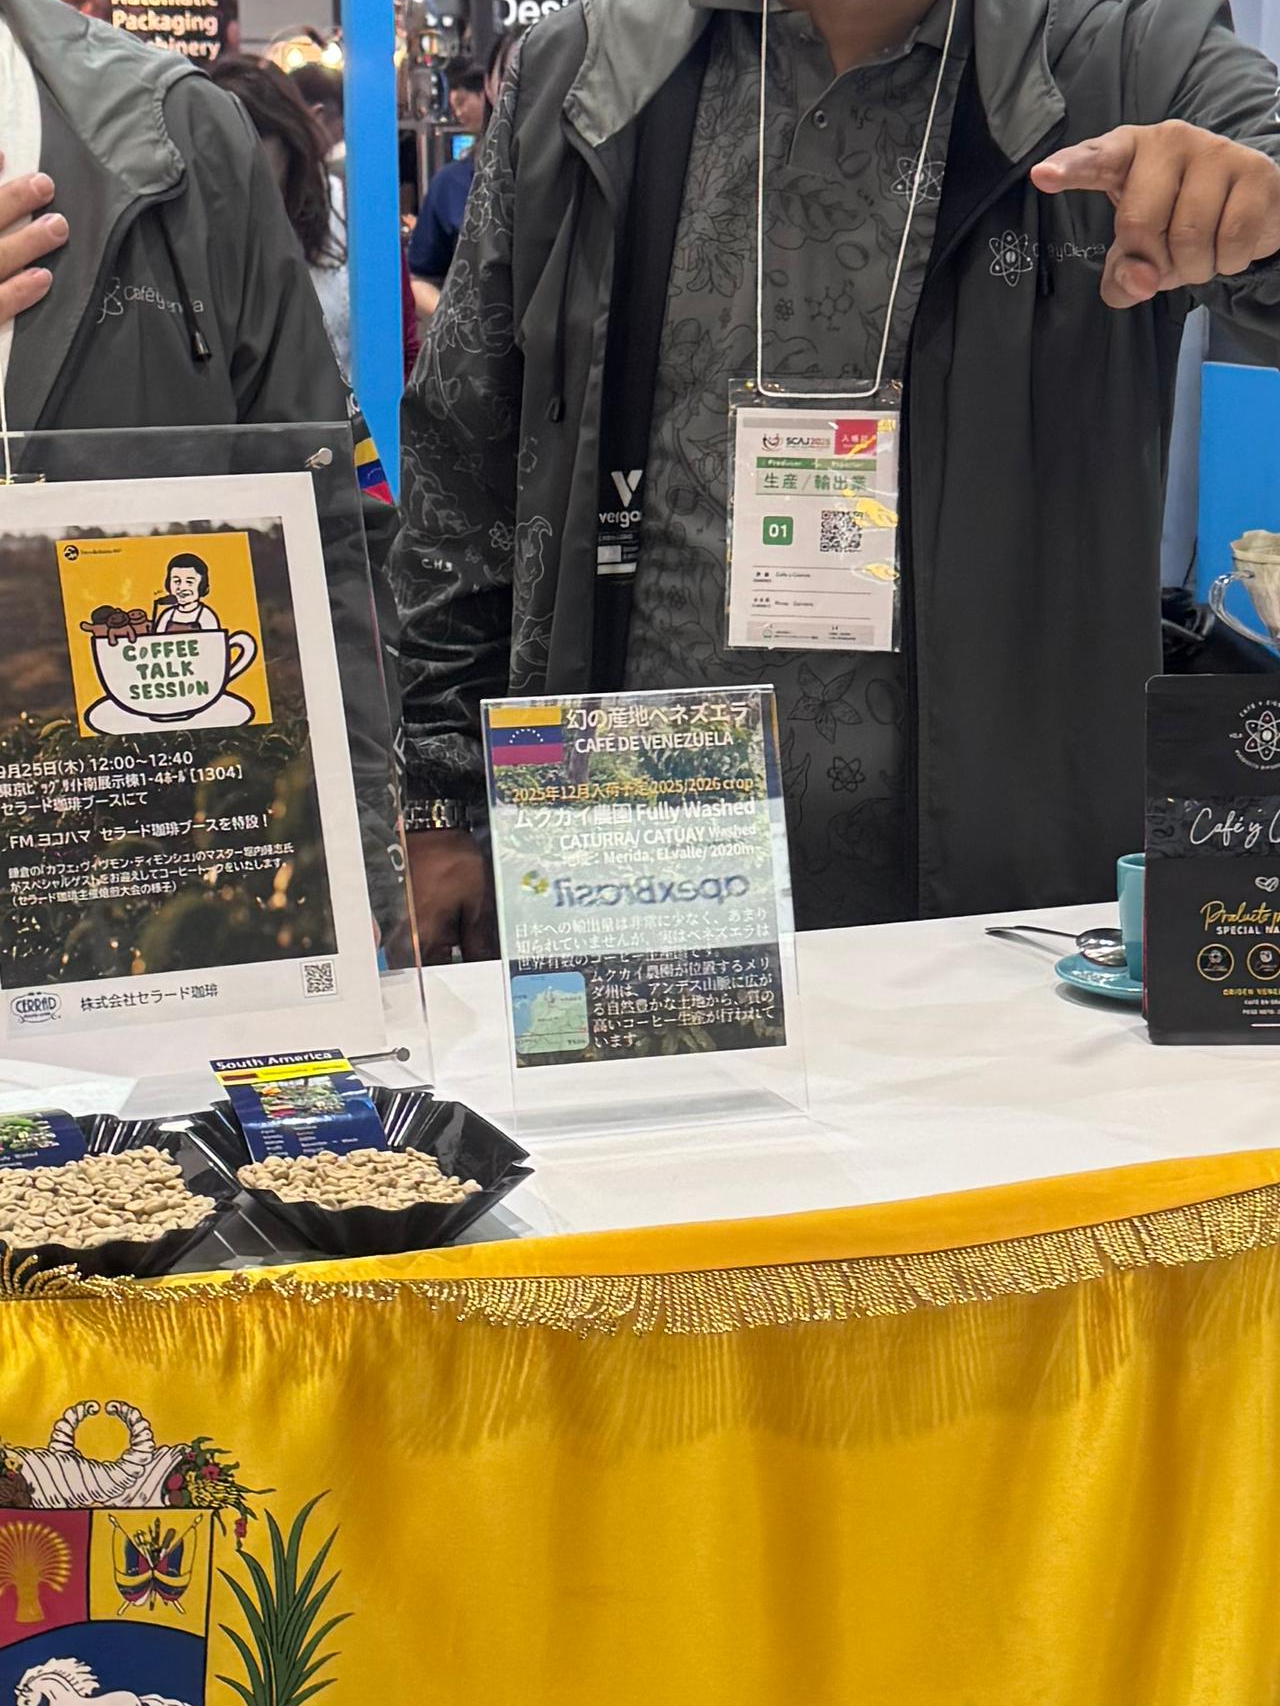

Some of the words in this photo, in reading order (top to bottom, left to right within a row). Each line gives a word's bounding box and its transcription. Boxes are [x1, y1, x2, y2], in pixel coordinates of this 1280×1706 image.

[112, 9, 218, 36] Packaging
[769, 524, 788, 538] 01
[122, 639, 199, 662] COFFEE
[136, 661, 195, 679] TALK
[129, 681, 209, 700] SESSION
[567, 702, 749, 730] 幻の産地ベネズエラ
[575, 733, 613, 753] CAFÉ
[621, 737, 640, 751] DE
[643, 732, 733, 750] VENEZUELA
[652, 778, 721, 796] 2025/2026
[723, 777, 753, 793] crop
[0, 791, 148, 817] セラード珈琲ブースにて
[637, 802, 682, 823] Fully
[683, 797, 755, 817] Washed
[643, 827, 705, 846] CATUAY
[1190, 806, 1244, 846] Café
[1243, 820, 1262, 849] y
[10, 835, 34, 850] FM
[37, 830, 90, 848] ヨコハマ
[1216, 925, 1261, 935] SPECIAL
[216, 1058, 264, 1071] South
[269, 1051, 333, 1066] America
